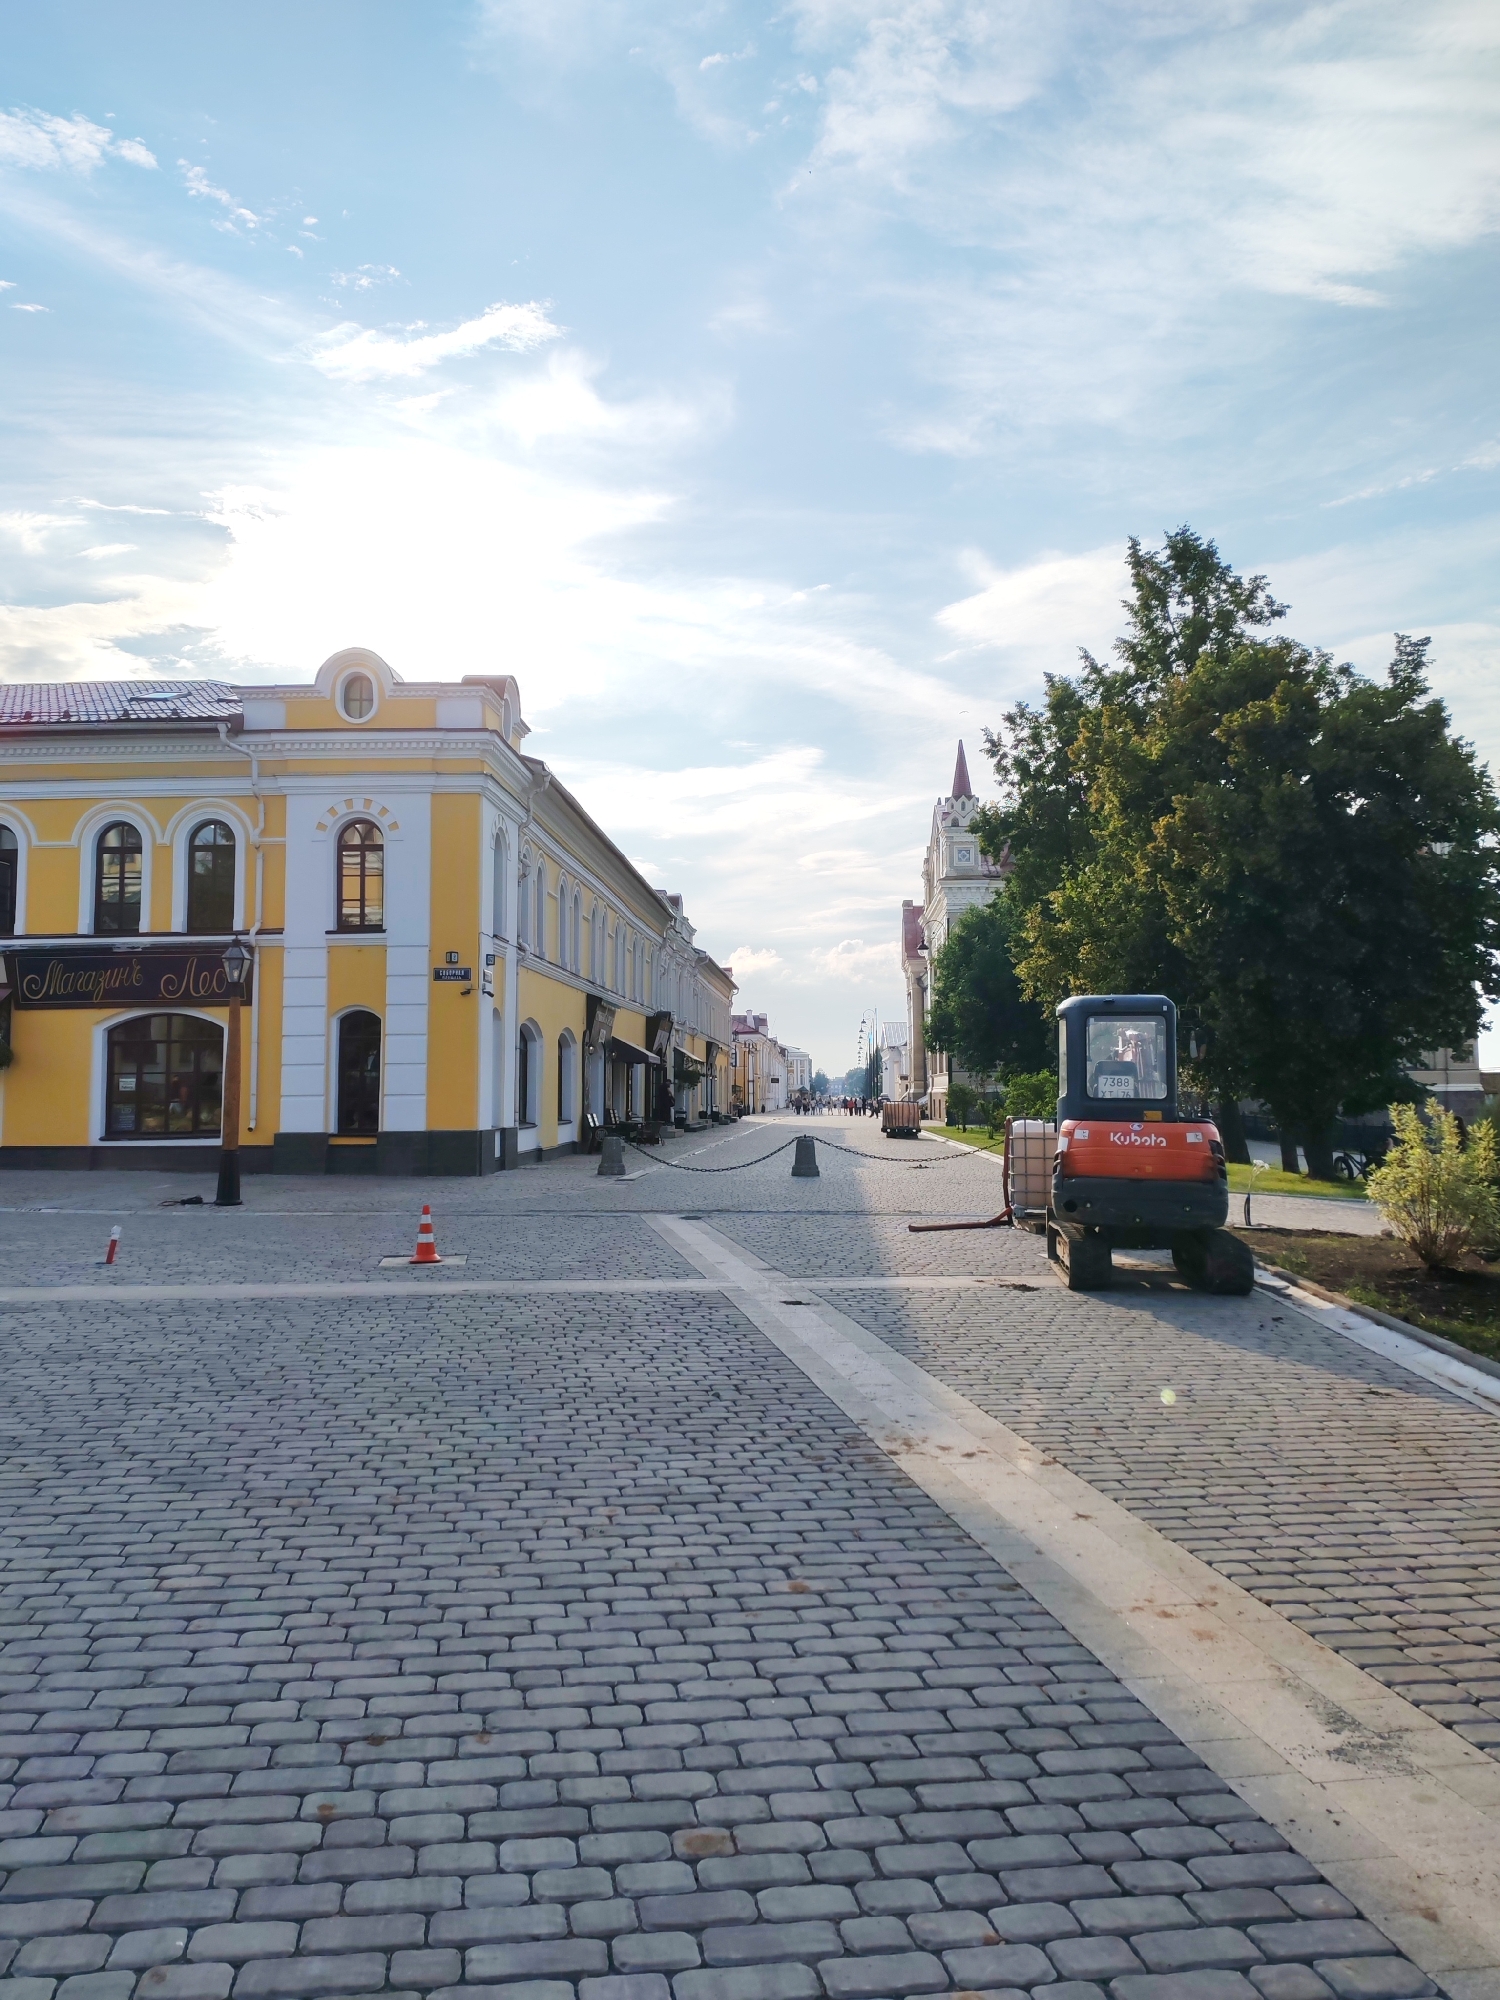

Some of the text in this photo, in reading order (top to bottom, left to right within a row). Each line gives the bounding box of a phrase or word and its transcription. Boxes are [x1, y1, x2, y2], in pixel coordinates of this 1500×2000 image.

[23, 959, 143, 1003] Магазинъ
[1102, 1077, 1130, 1087] 7388
[1110, 1132, 1167, 1147] Kubota
